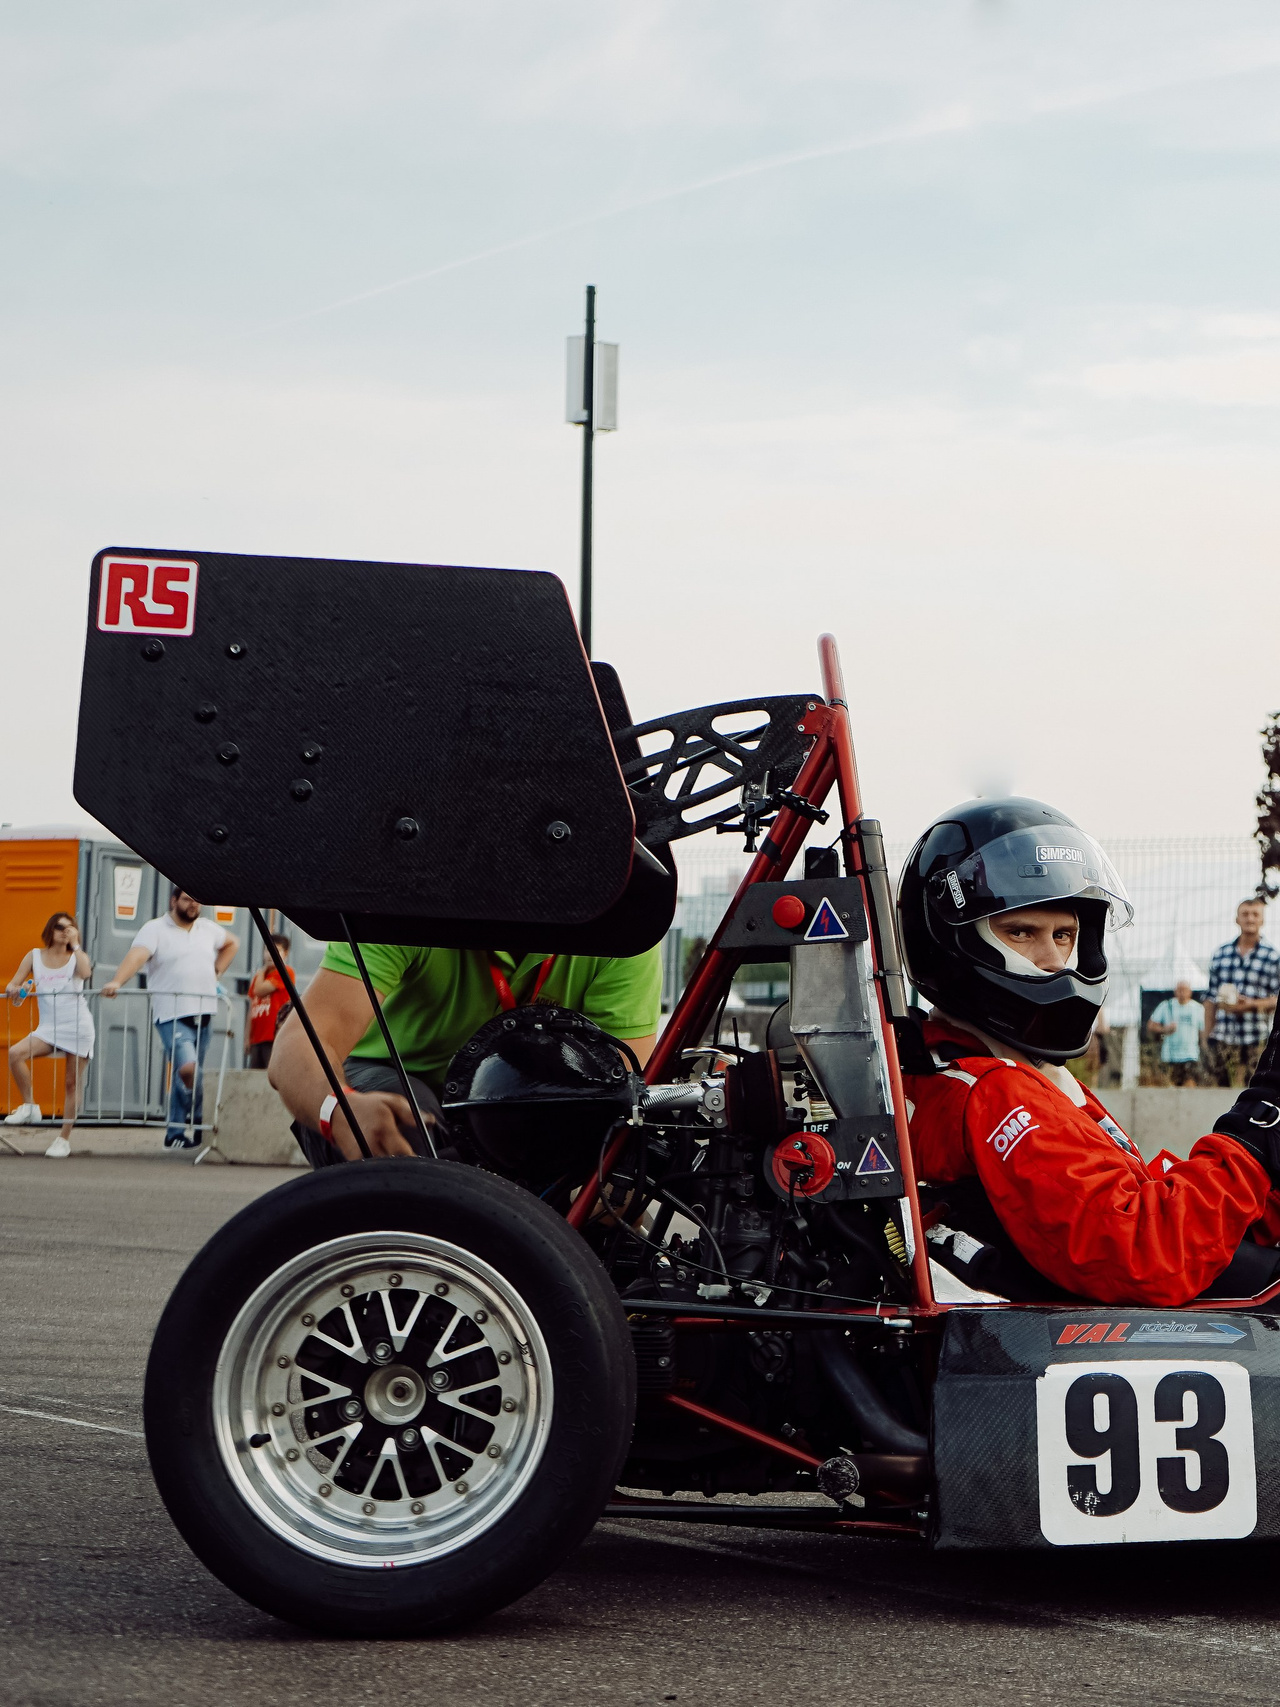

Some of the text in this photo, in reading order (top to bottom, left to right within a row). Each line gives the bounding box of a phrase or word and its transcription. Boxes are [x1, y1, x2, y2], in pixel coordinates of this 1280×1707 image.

[104, 563, 192, 630] RS
[1040, 847, 1084, 862] SIMPSON
[949, 874, 964, 906] SIMPSON
[810, 1124, 829, 1133] OFF
[994, 1111, 1032, 1153] OMP
[837, 1162, 852, 1170] ON
[1056, 1320, 1198, 1345] VAL racing
[1064, 1371, 1230, 1518] 93
